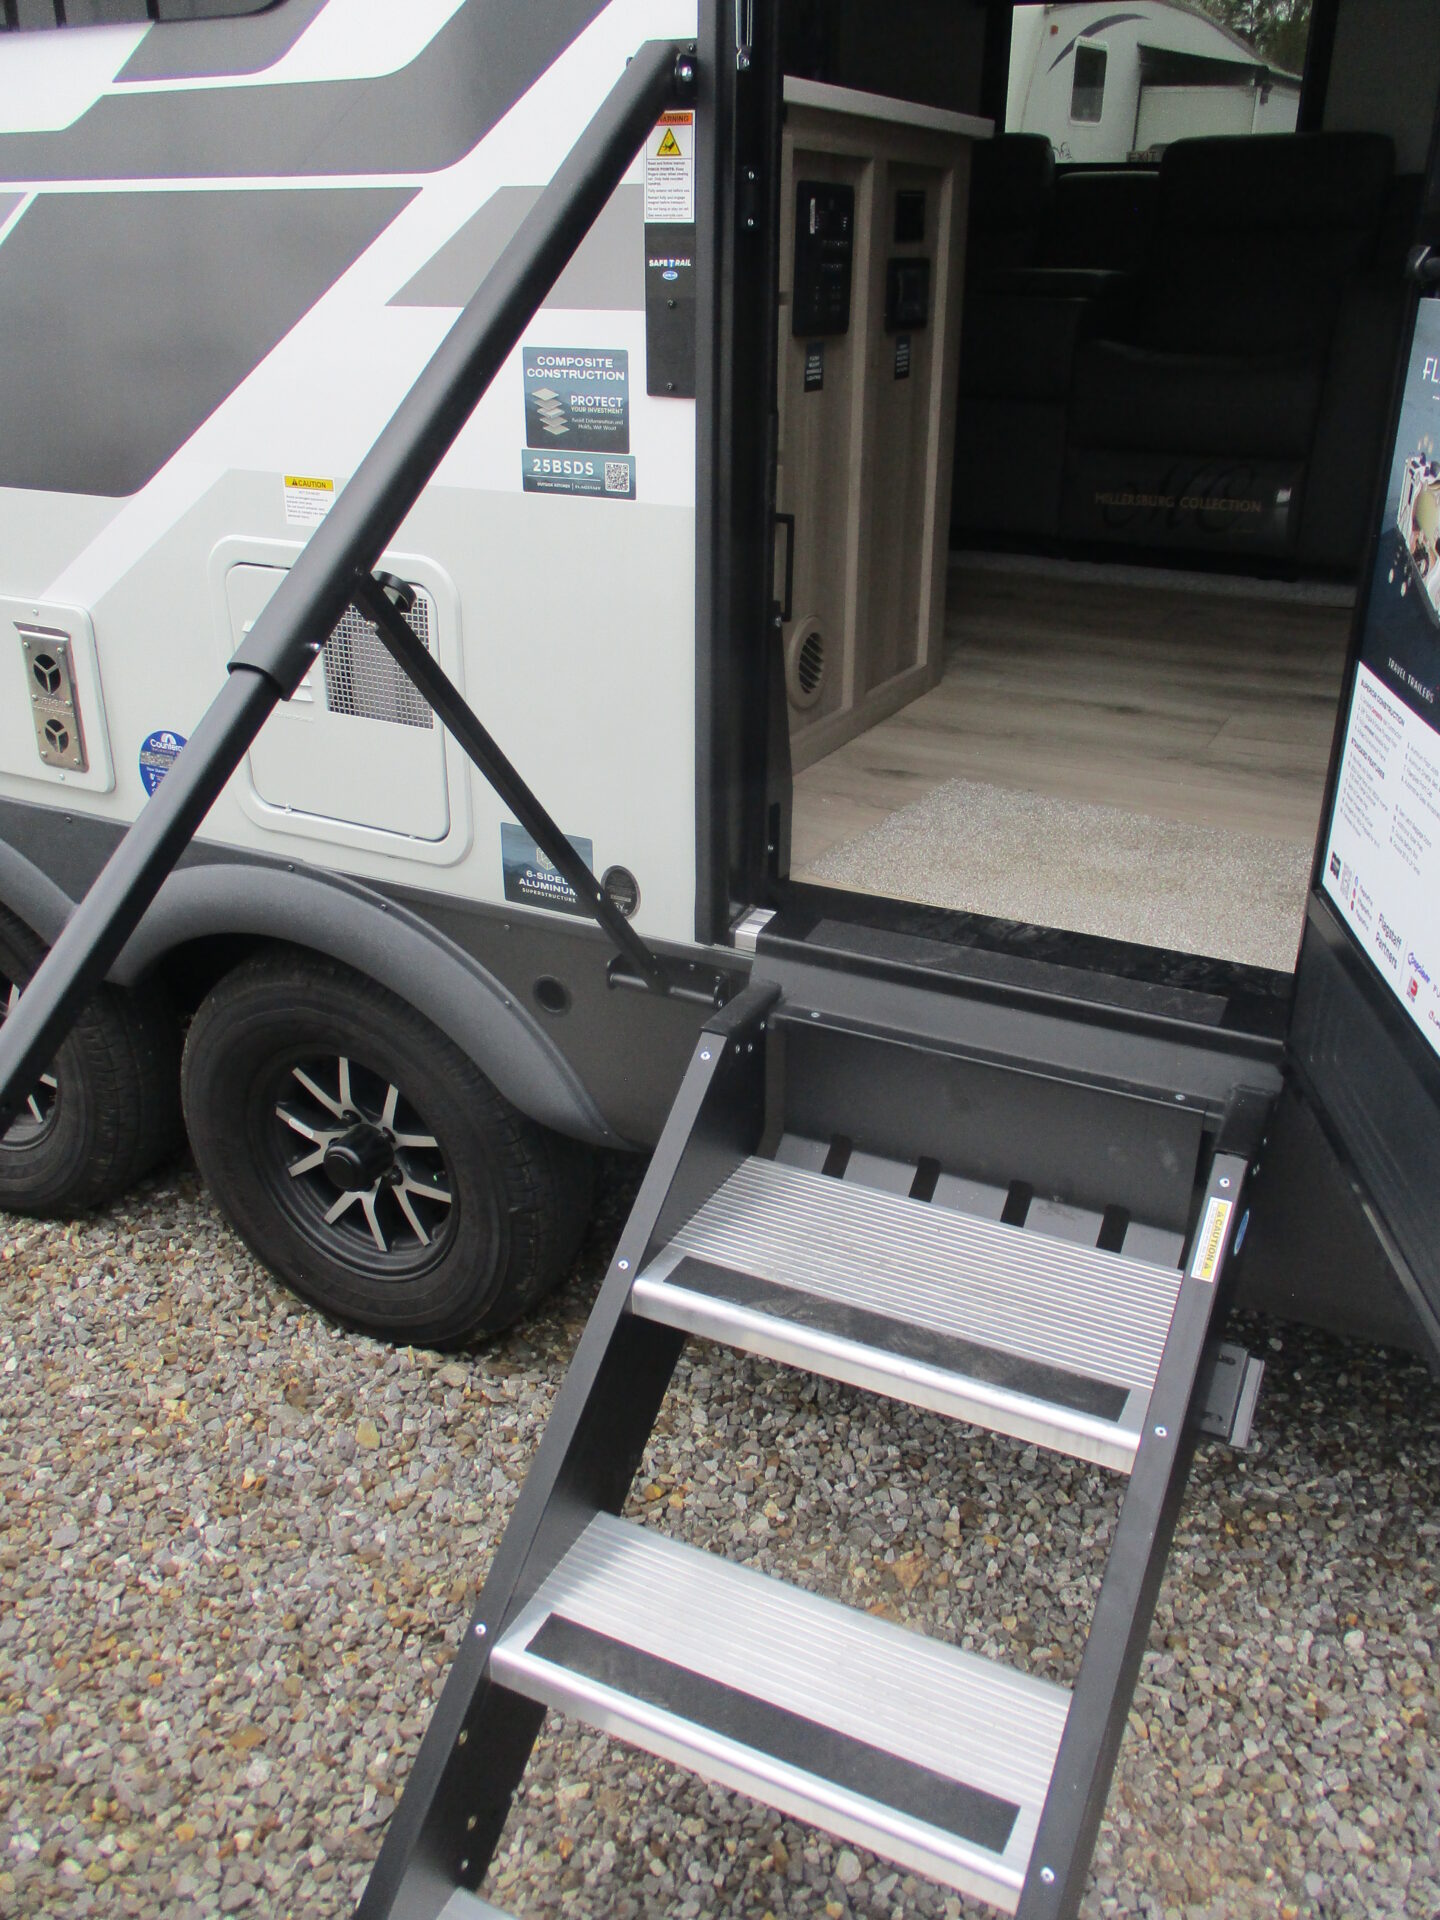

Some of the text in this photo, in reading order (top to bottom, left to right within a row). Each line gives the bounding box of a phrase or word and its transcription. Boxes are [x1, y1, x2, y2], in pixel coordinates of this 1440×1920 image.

[1129, 151, 1157, 161] EXIT
[537, 356, 613, 368] COMPOSITE
[527, 368, 625, 381] CONSTRUCTION
[570, 395, 623, 407] PROTECT
[533, 458, 594, 476] 25BSDS
[298, 479, 327, 489] CAUTION
[1093, 490, 1264, 514] MILLERSBURG COLLECTION
[1387, 657, 1435, 704] TRAVEL TRAILERS
[522, 887, 577, 904] SUPERSTRUCTURE
[1378, 912, 1402, 951] Flagstaff
[1375, 931, 1398, 970] Partners
[1206, 1218, 1223, 1262] CAUTION
